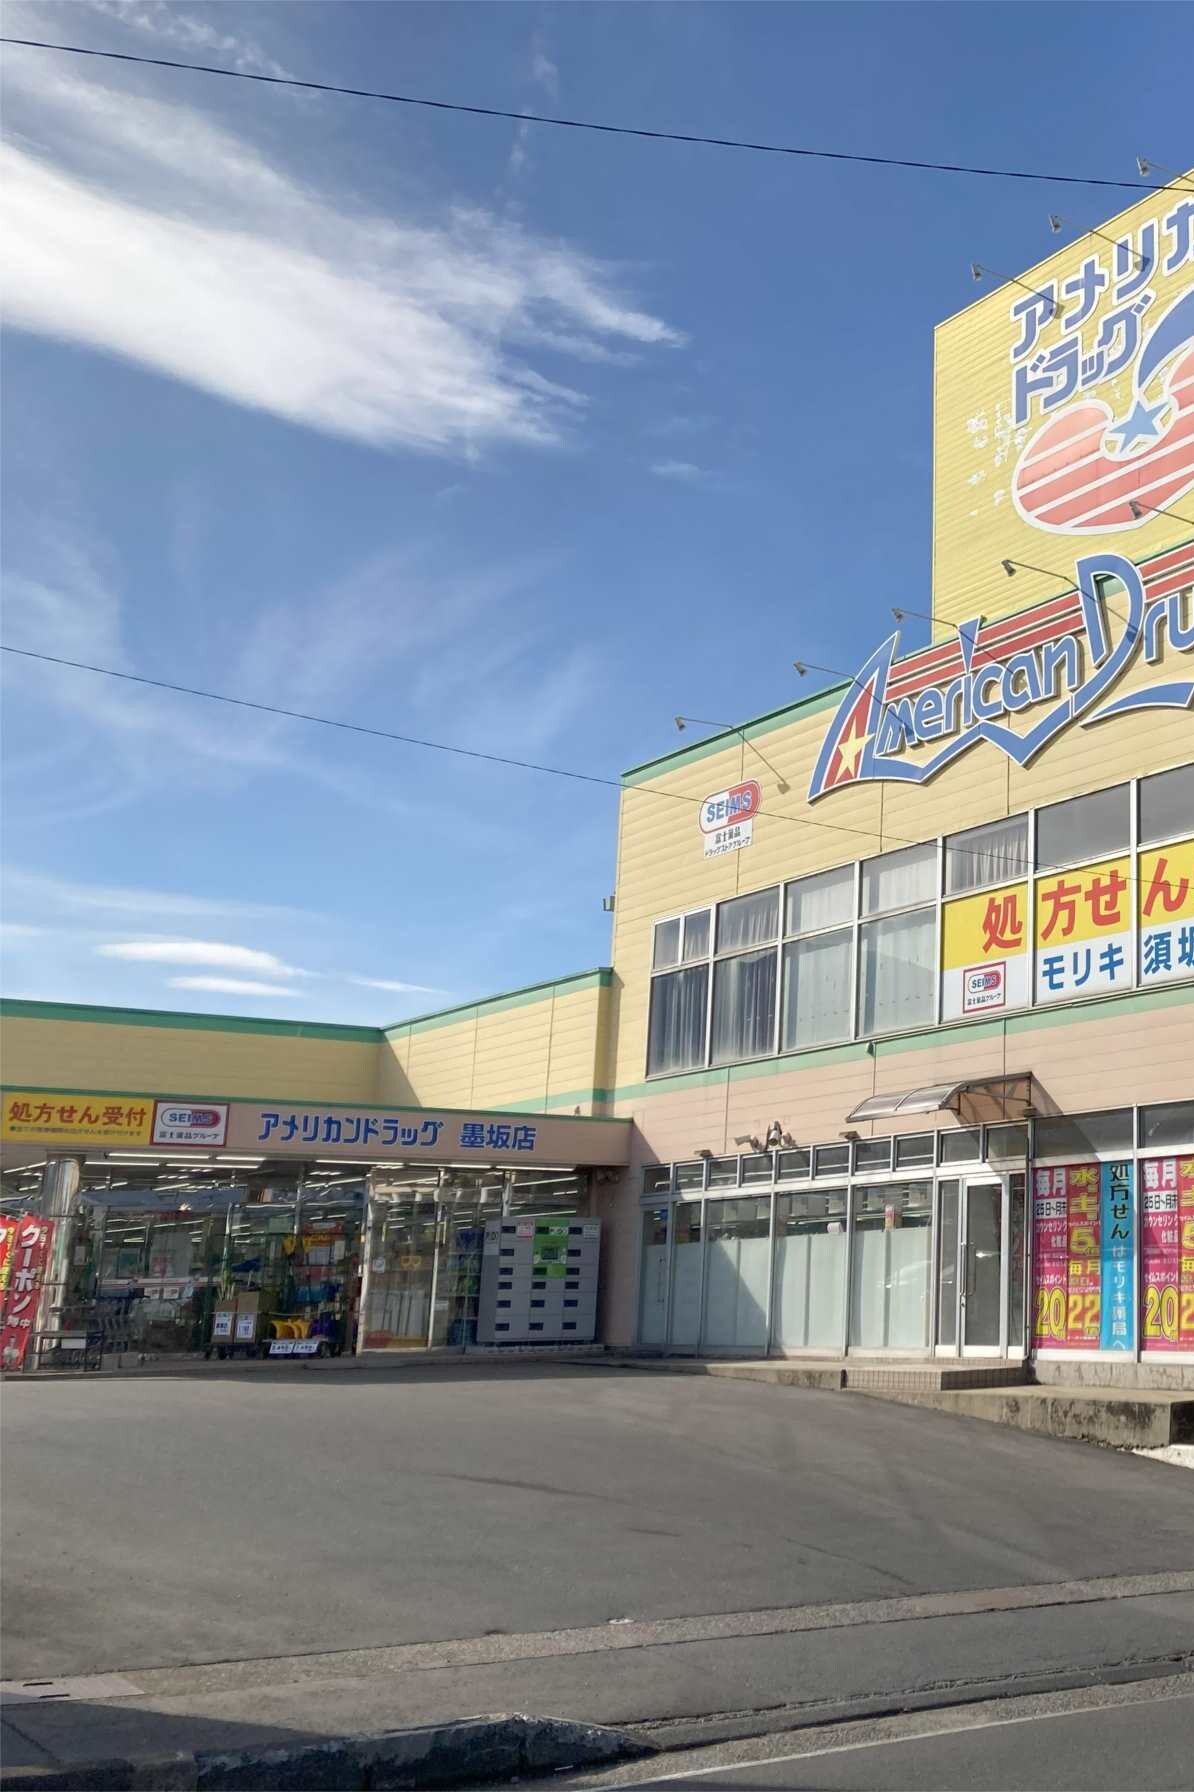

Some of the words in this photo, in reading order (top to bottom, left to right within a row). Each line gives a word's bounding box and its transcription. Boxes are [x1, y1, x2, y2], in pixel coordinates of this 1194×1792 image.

[1011, 288, 1157, 429] ドラッグ
[808, 616, 1077, 804] American
[707, 791, 753, 824] SEIMS
[971, 975, 997, 989] SEIMS
[9, 1101, 147, 1127] 処方せん受付
[168, 1112, 213, 1124] SEIMS
[257, 1112, 444, 1147] アメリカンドラッグ
[459, 1122, 537, 1151] 墨坂店
[1144, 1159, 1177, 1190] 毎月
[11, 1224, 41, 1314] クーポン
